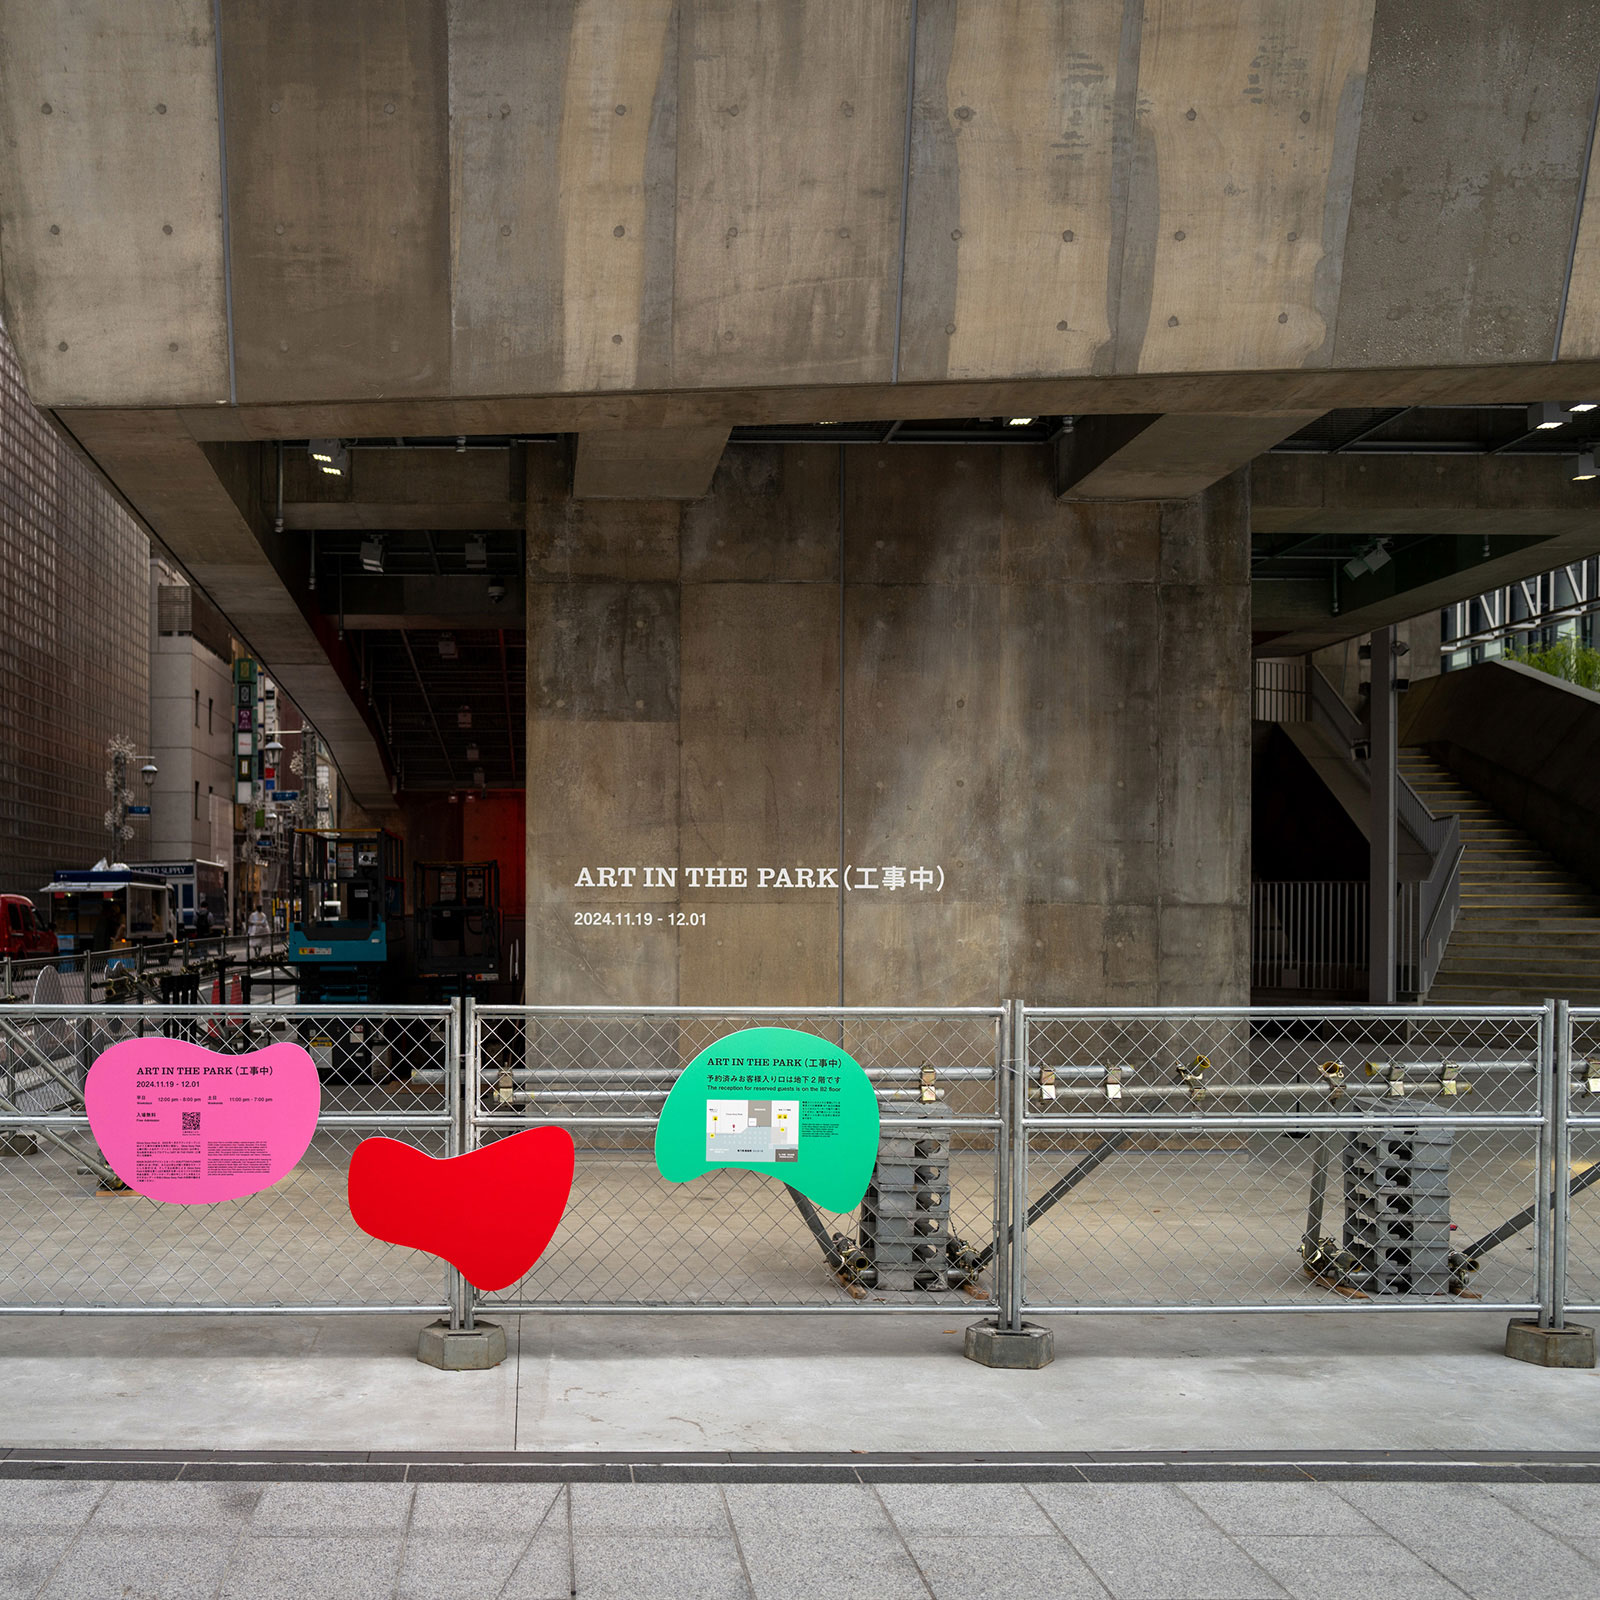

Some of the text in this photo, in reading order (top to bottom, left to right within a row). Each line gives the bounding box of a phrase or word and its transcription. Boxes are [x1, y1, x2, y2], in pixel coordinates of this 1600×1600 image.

[574, 864, 945, 892] ART IN THE PARK （工事中）
[574, 911, 653, 926] 2024.11.19
[668, 911, 706, 926] 12.01
[707, 1057, 842, 1069] ART IN THE PARK （工事中）
[136, 1065, 273, 1076] ART IN THE PARK （工事中）
[136, 1080, 175, 1088] 2024.11.19
[181, 1080, 200, 1088] 12.01
